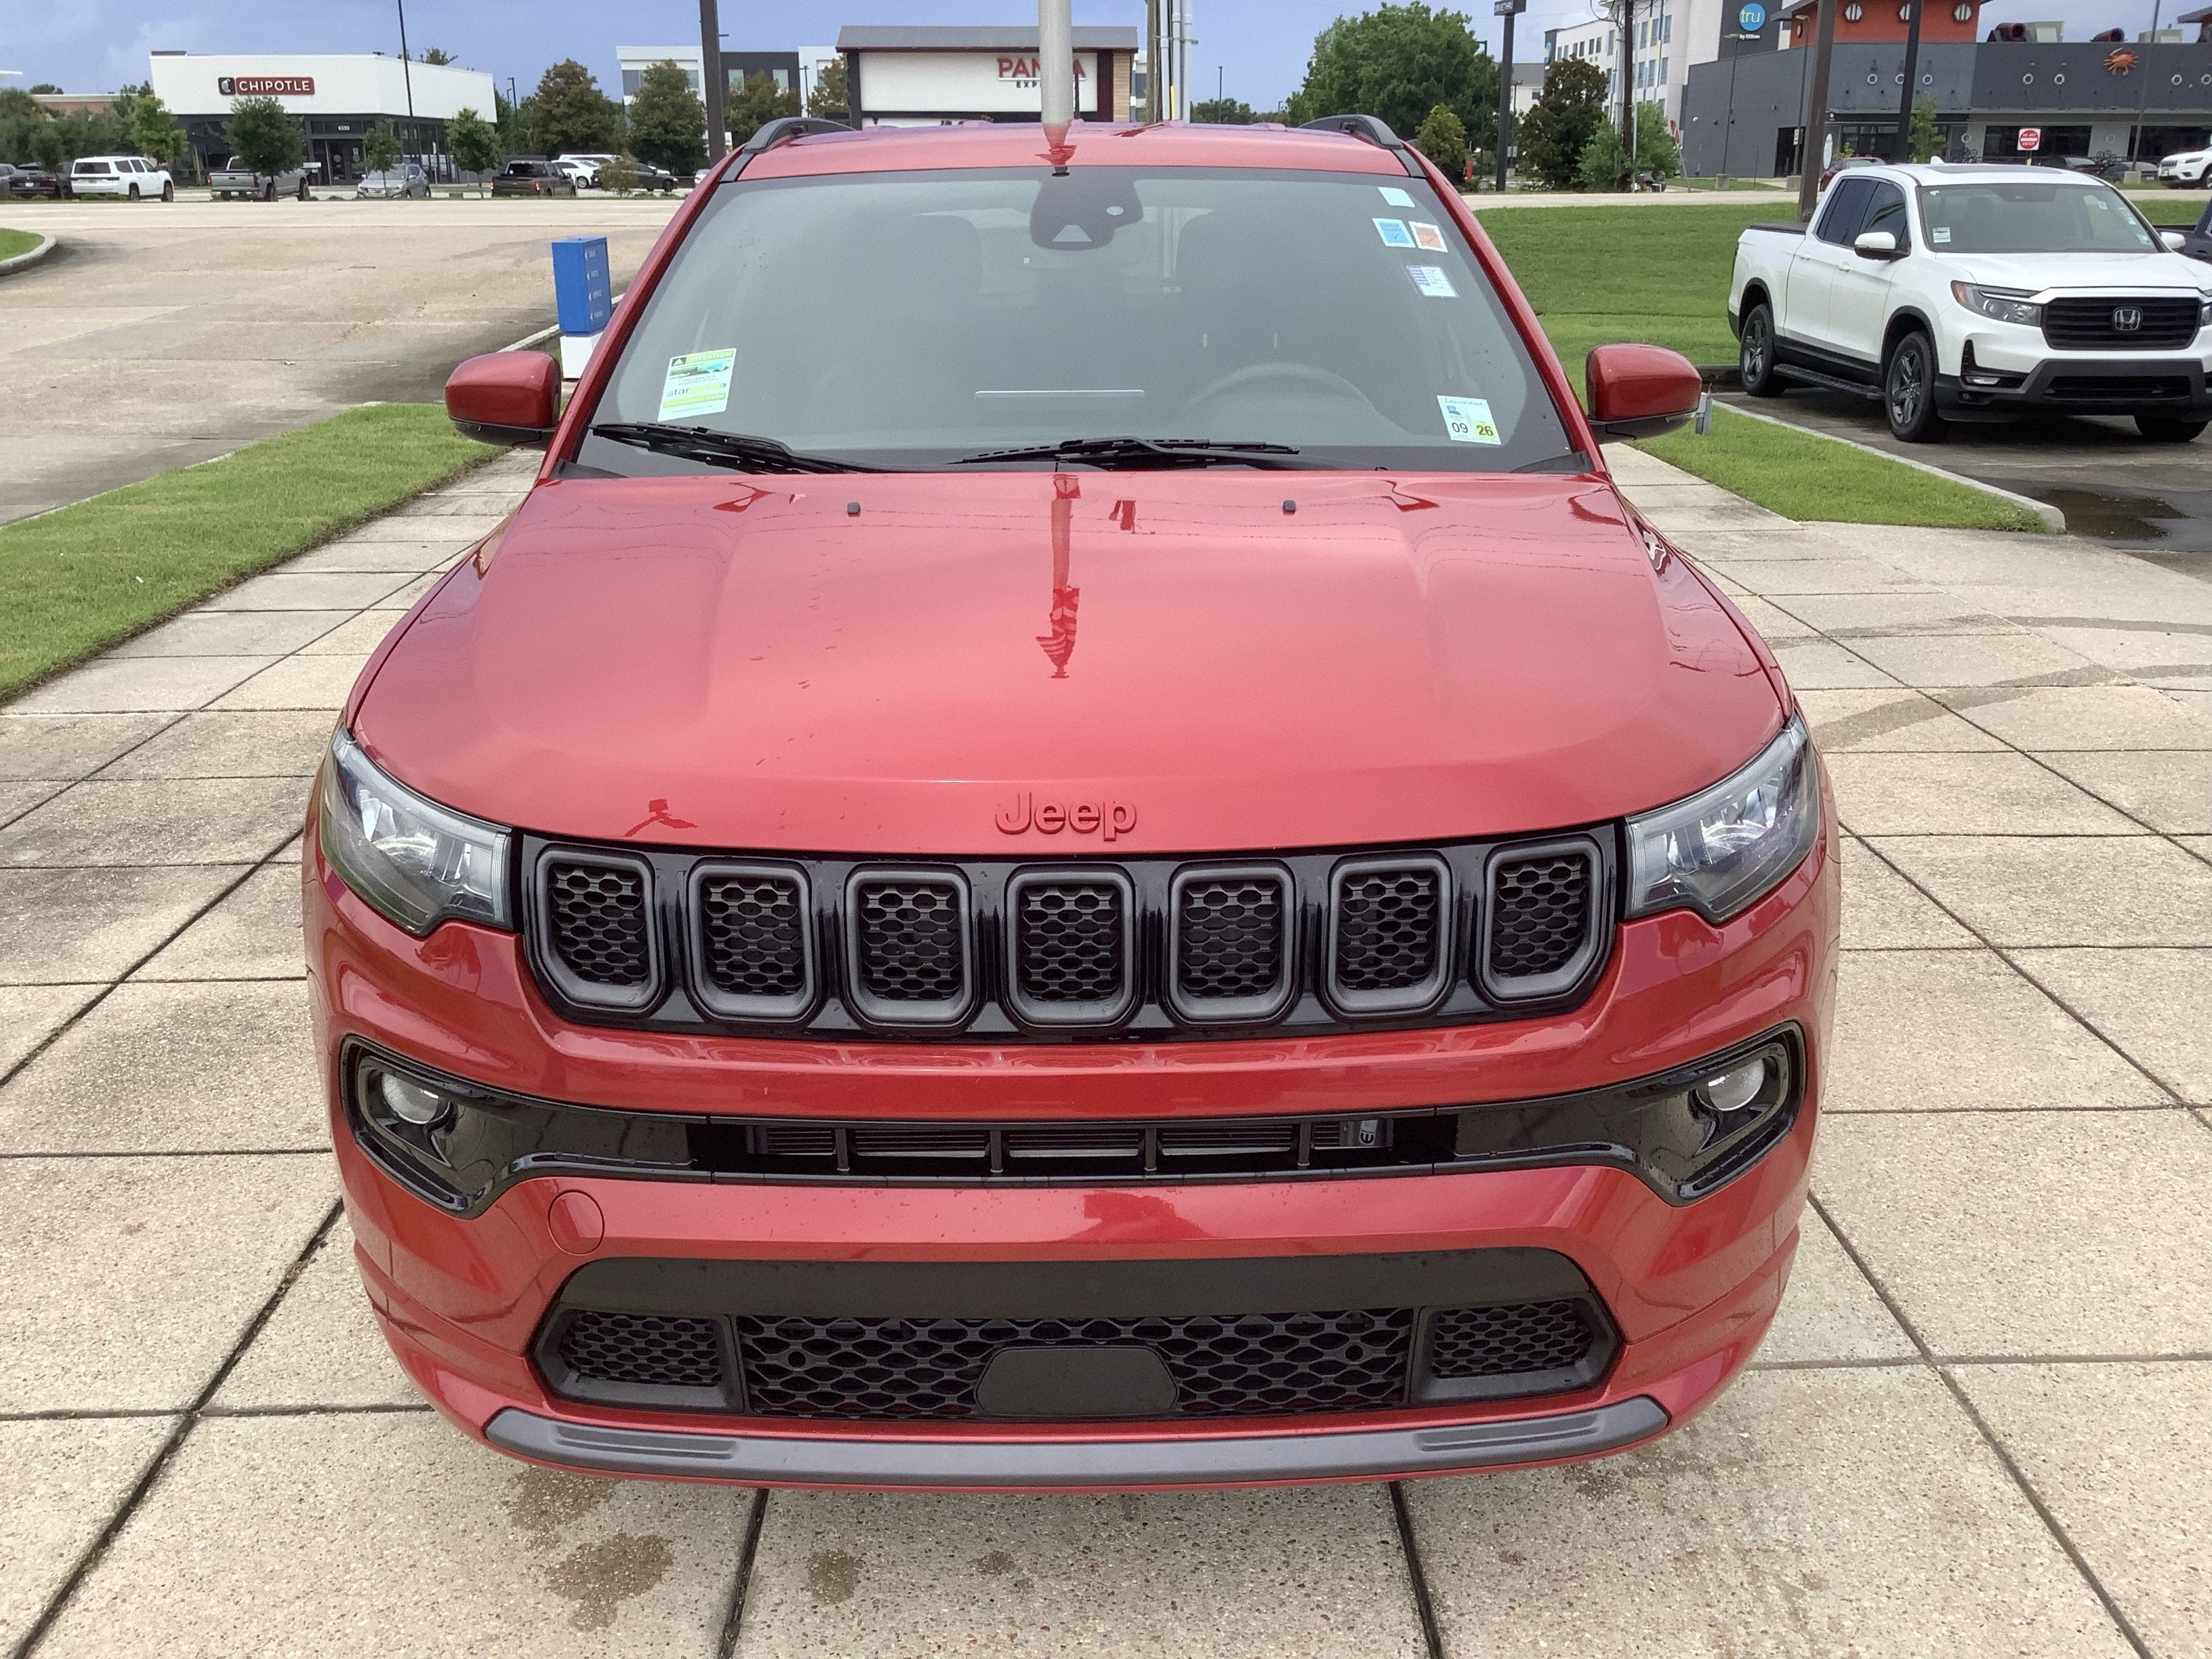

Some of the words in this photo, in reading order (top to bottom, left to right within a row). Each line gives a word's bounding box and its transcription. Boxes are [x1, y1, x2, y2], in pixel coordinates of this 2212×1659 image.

[1740, 9, 1761, 24] tru
[997, 57, 1086, 78] PANA
[239, 80, 310, 91] CHIPOTLE
[687, 351, 733, 363] ATTENTION
[1452, 422, 1469, 434] 09
[1476, 425, 1494, 436] 26
[995, 791, 1136, 842] Jeep
